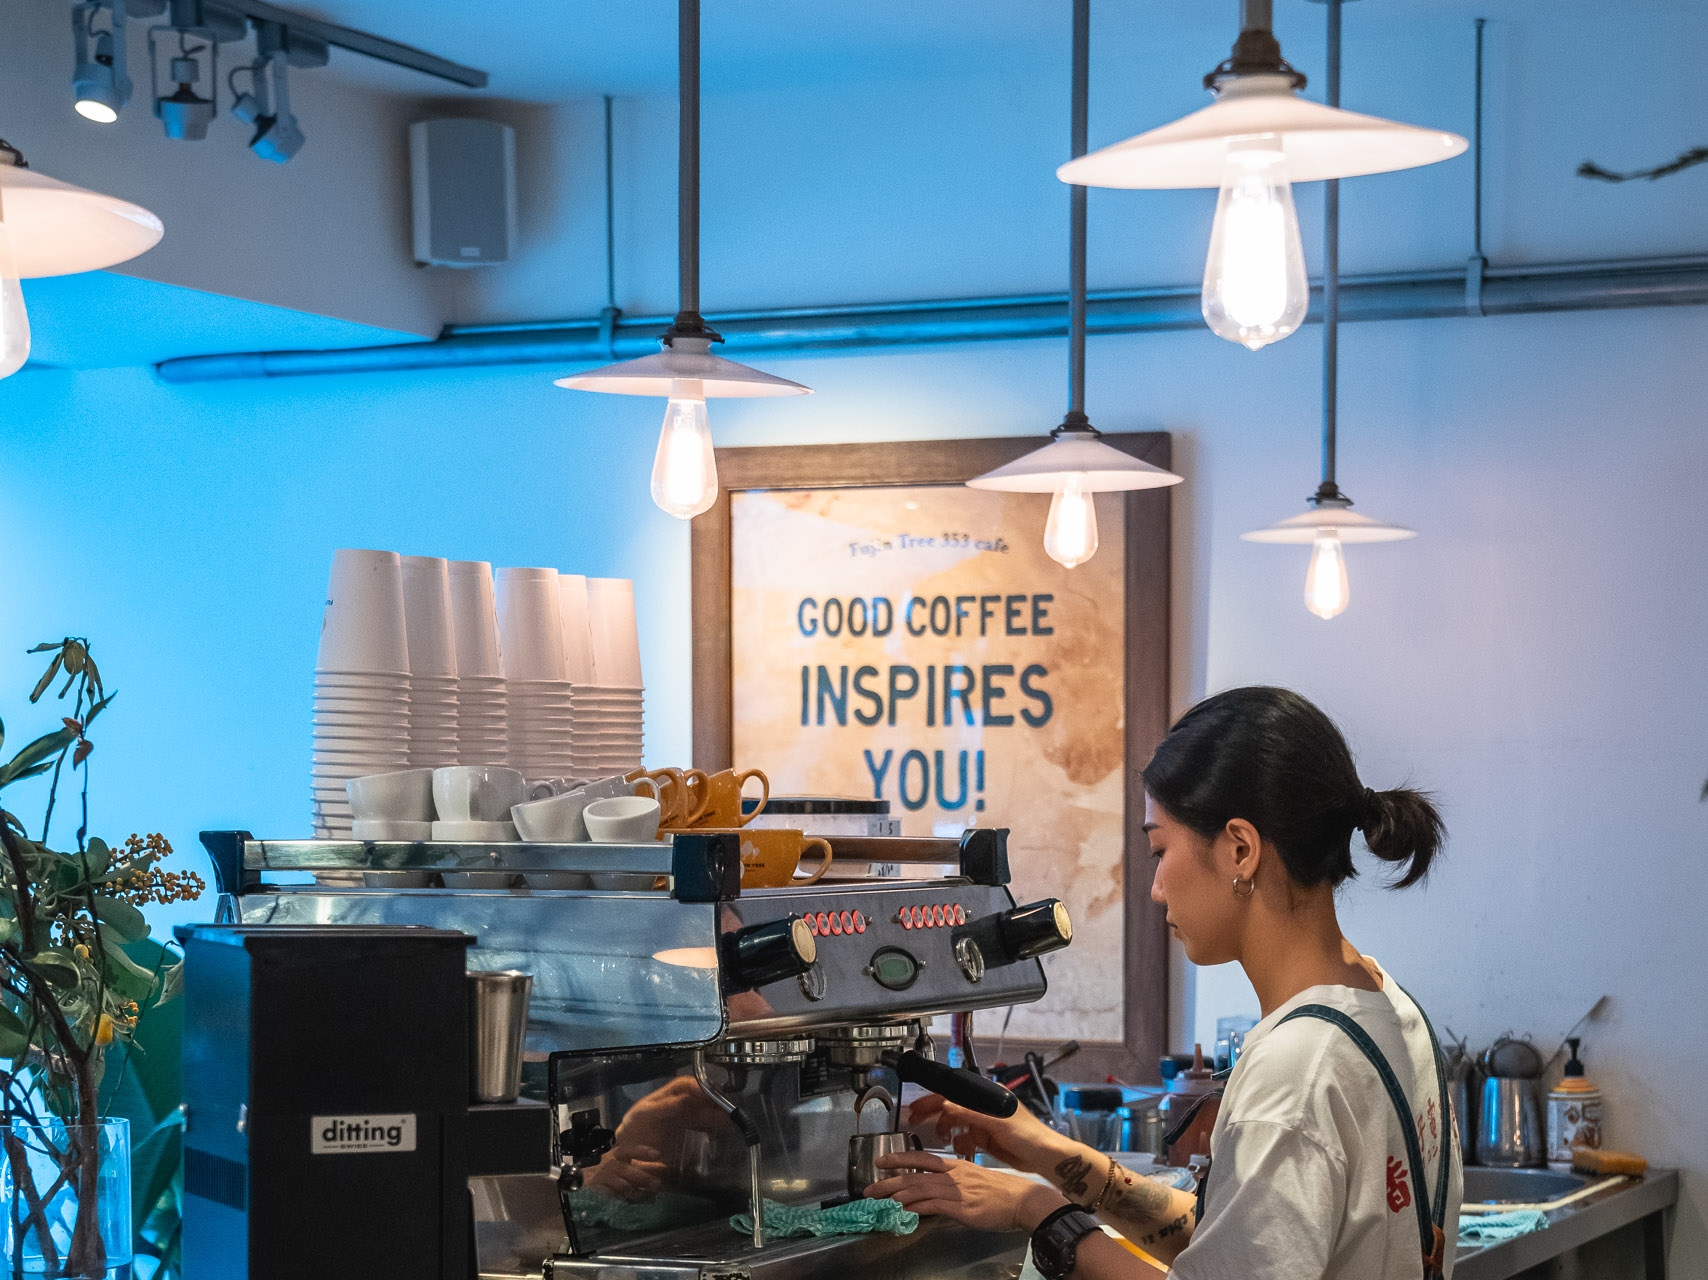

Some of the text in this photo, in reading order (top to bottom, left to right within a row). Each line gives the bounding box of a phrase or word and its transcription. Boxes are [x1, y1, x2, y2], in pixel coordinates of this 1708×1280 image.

[897, 532, 936, 550] Tree
[941, 532, 970, 549] 353
[974, 537, 1009, 554] cafe
[797, 593, 1055, 638] GOOD COFFEE
[800, 663, 1054, 728] INSPIRES
[863, 748, 986, 812] YOU!
[322, 1119, 402, 1147] ditting
